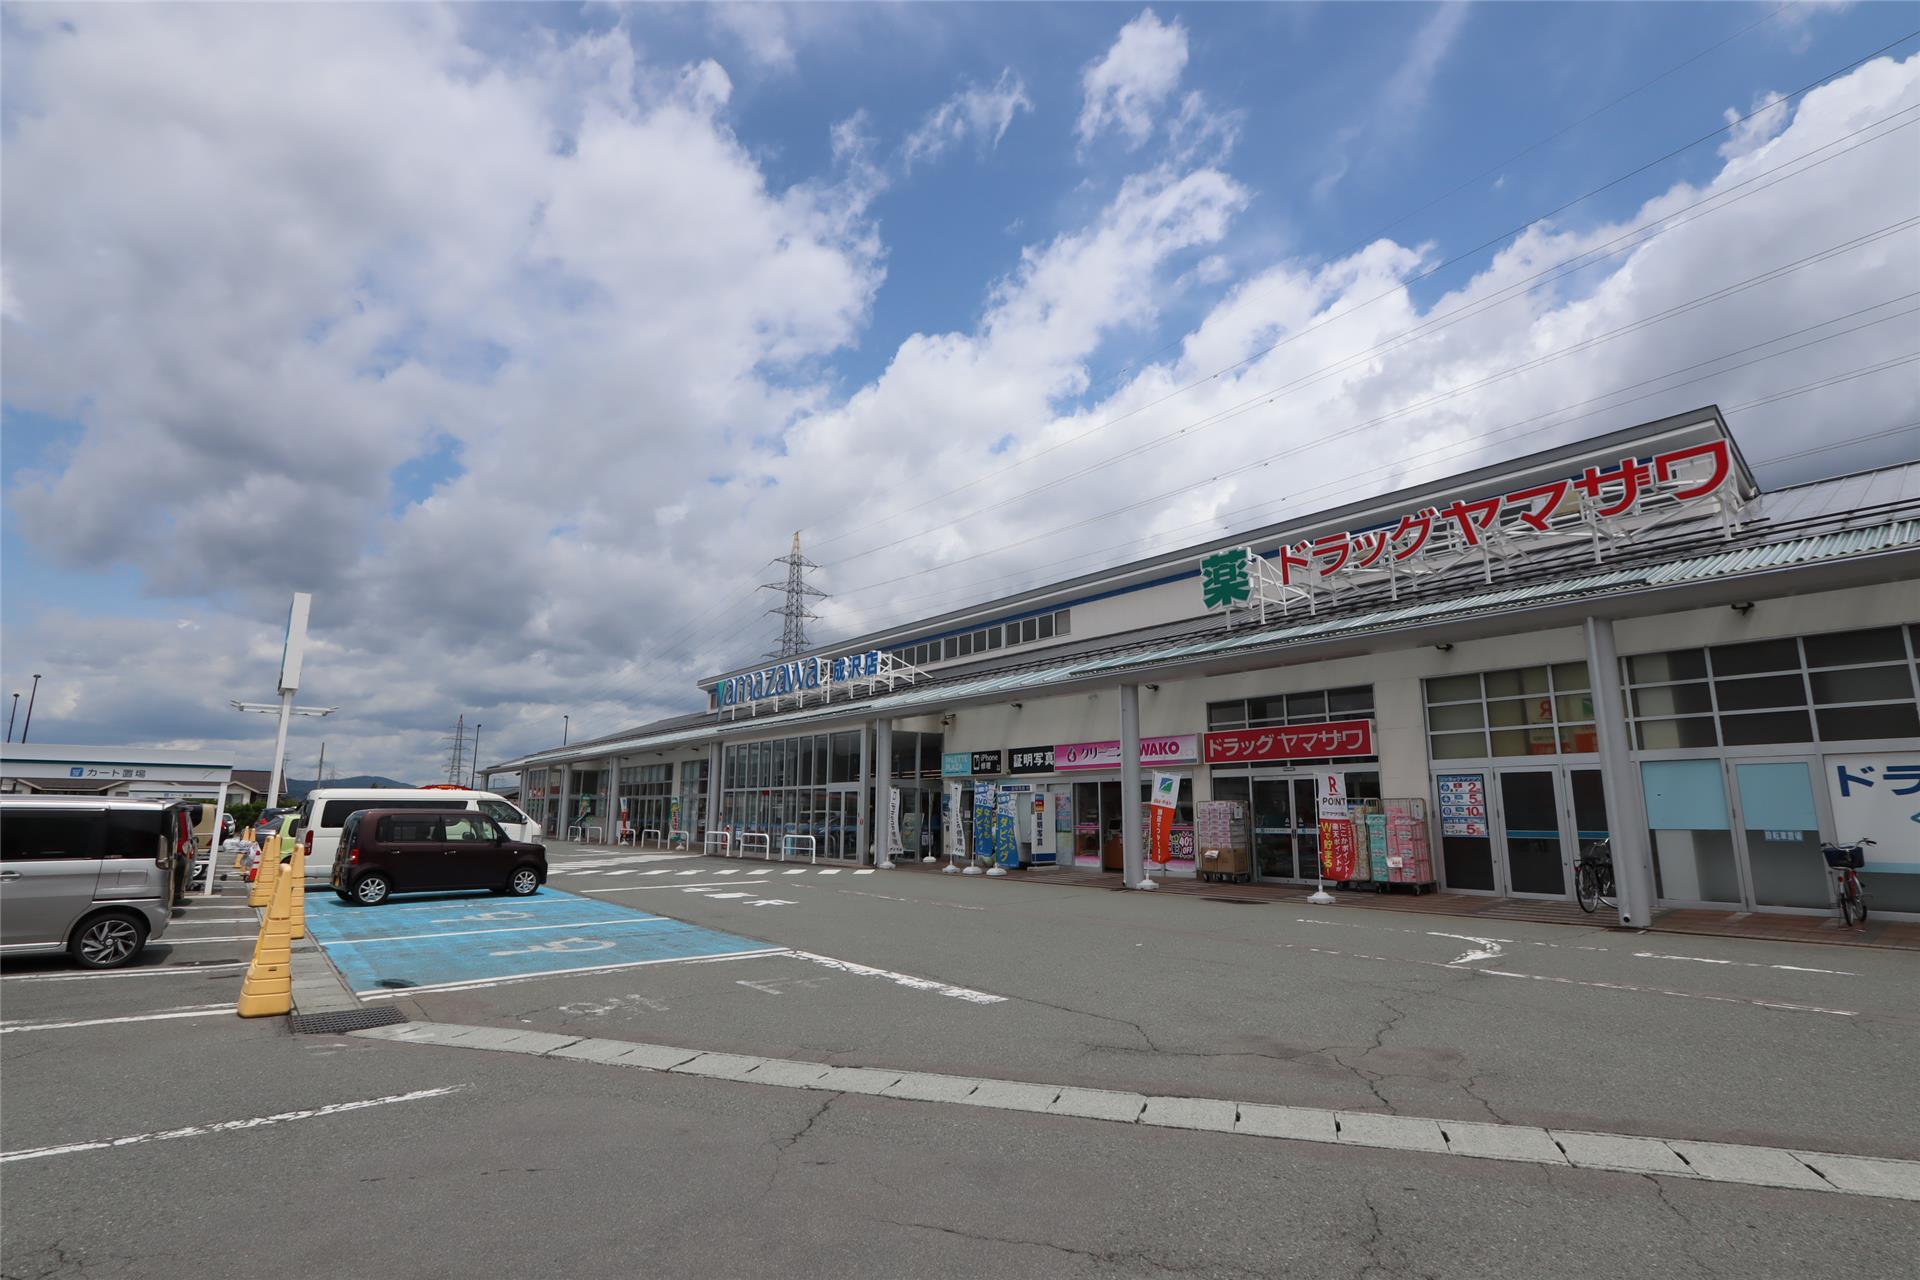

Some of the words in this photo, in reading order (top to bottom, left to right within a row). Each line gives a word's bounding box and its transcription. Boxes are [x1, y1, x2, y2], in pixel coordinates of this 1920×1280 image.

[1200, 548, 1253, 610] 薬
[1278, 438, 1732, 588] ドラッグヤマザワ
[833, 649, 881, 682] 成沢店
[1139, 740, 1180, 756] WAKO
[1209, 728, 1363, 758] ドラッグヤマザワ
[980, 753, 999, 766] iPhone
[1013, 751, 1054, 768] 証明写真
[87, 767, 146, 779] カート置場
[1327, 775, 1338, 793] R
[1321, 796, 1346, 806] POINT
